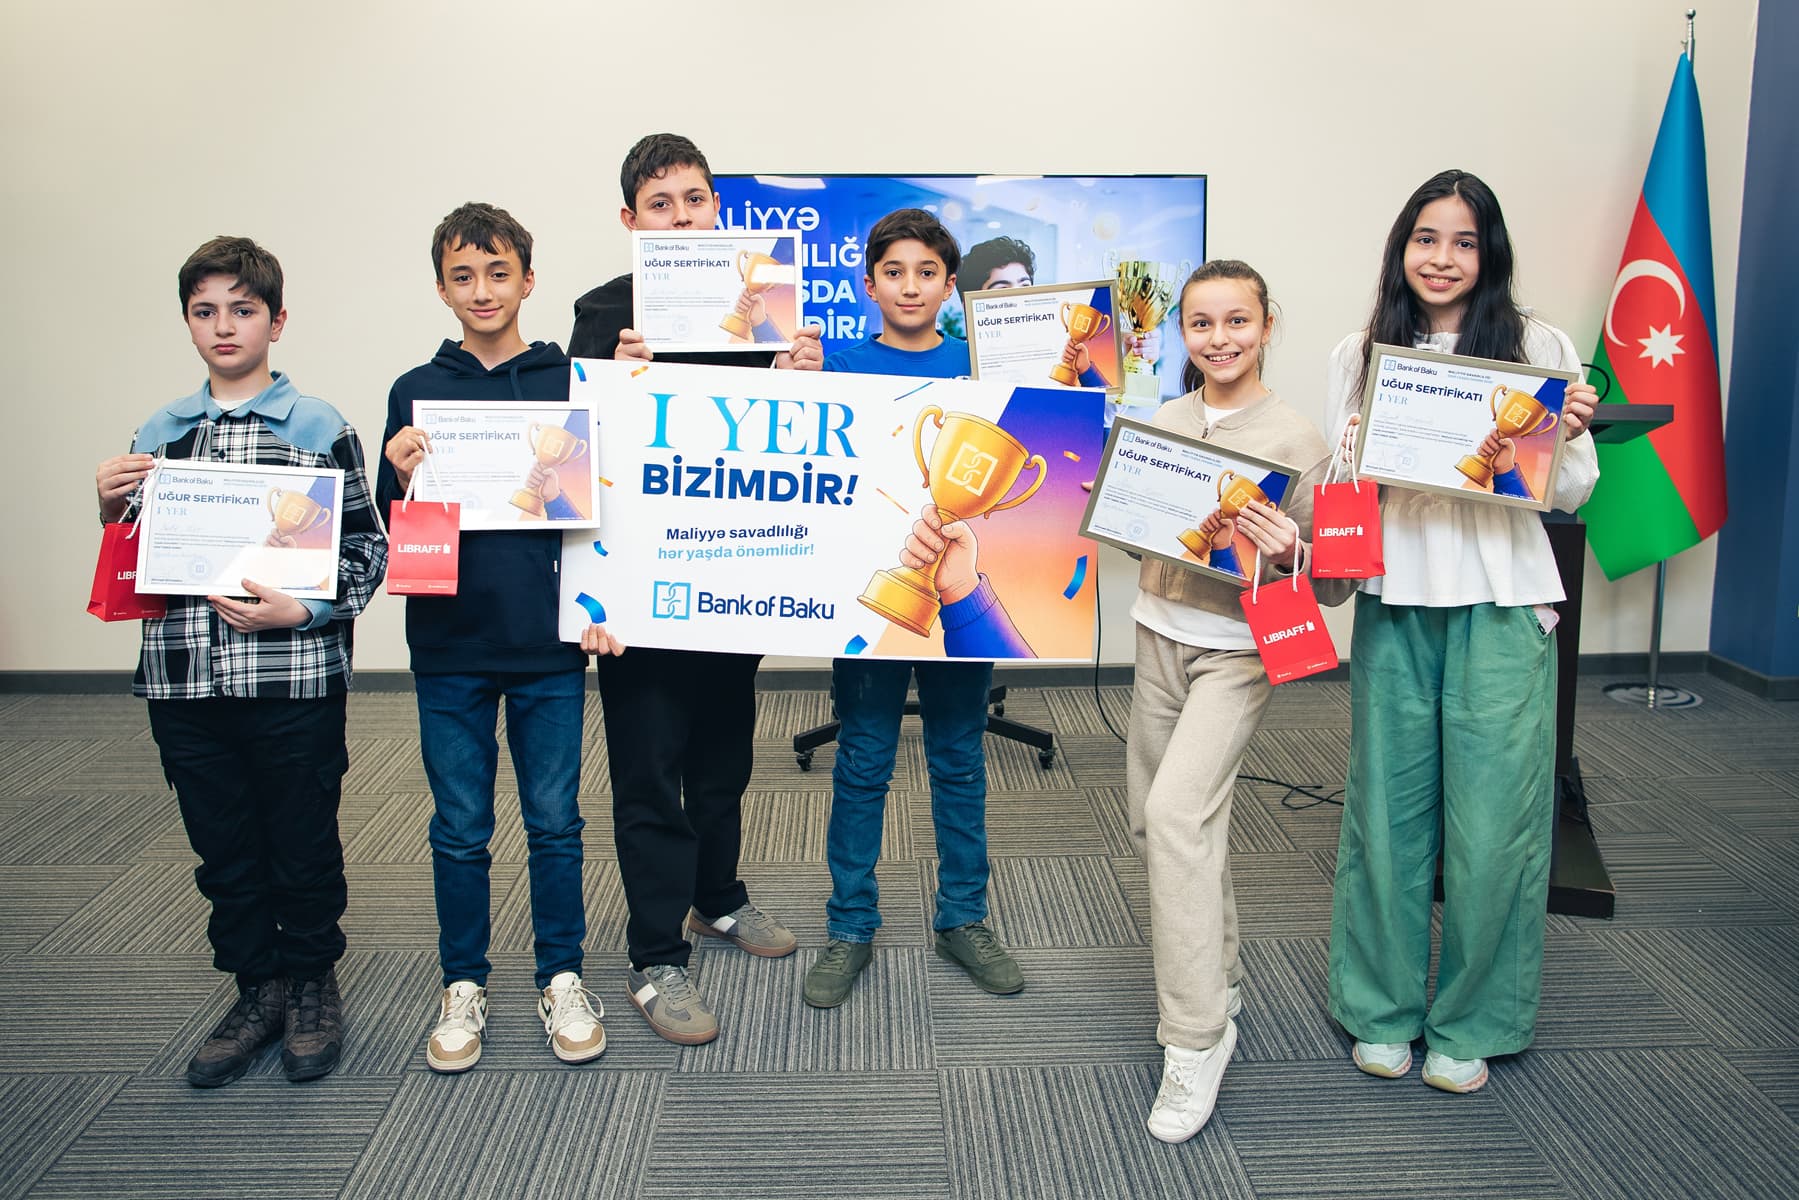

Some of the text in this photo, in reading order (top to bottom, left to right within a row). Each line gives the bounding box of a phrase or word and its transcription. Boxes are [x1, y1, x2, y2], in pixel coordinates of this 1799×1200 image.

[714, 200, 820, 231] ALİYYƏ
[644, 258, 730, 268] UĞUR SERTİFİKATI
[977, 313, 1055, 327] UĞUR SERTİFİKATI
[1397, 363, 1437, 375] Bank of Baku
[1381, 378, 1483, 402] UĞUR SERTİFİKATI
[644, 393, 859, 458] I YER
[459, 430, 520, 440] SERTİFİKATI
[1135, 435, 1150, 445] Bank
[1156, 442, 1173, 453] Baku
[1118, 448, 1148, 464] UĞUR
[1149, 458, 1211, 483] SERTİFİKATI
[196, 477, 213, 485] Baku
[642, 455, 859, 505] BİZİMDİR!
[158, 491, 260, 505] UĞUR SERTİFİKATI
[666, 525, 808, 542] Maliyyə savadlılığı
[1319, 527, 1356, 537] LIBRAFF
[397, 543, 441, 554] LIBRAFF
[658, 544, 814, 561] hər yaşda önəmlidir!
[698, 592, 835, 620] Bank of Baku
[1263, 624, 1305, 645] LIBRAFF
